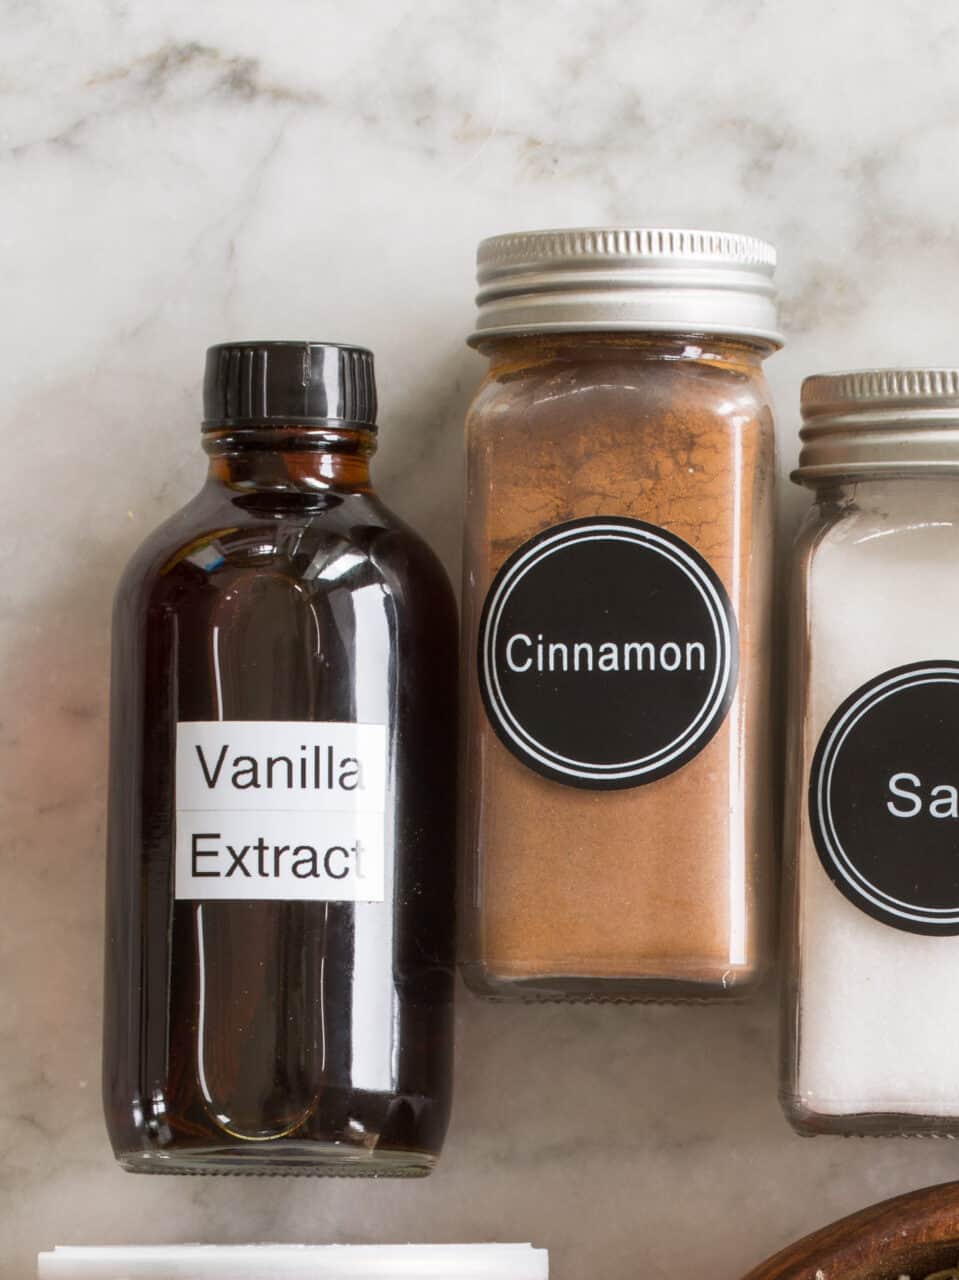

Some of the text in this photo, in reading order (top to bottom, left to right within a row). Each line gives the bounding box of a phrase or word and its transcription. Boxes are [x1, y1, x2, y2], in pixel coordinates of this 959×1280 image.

[506, 633, 706, 672] Cinnamon
[195, 744, 366, 790] Vanilla
[191, 833, 366, 879] Extract
